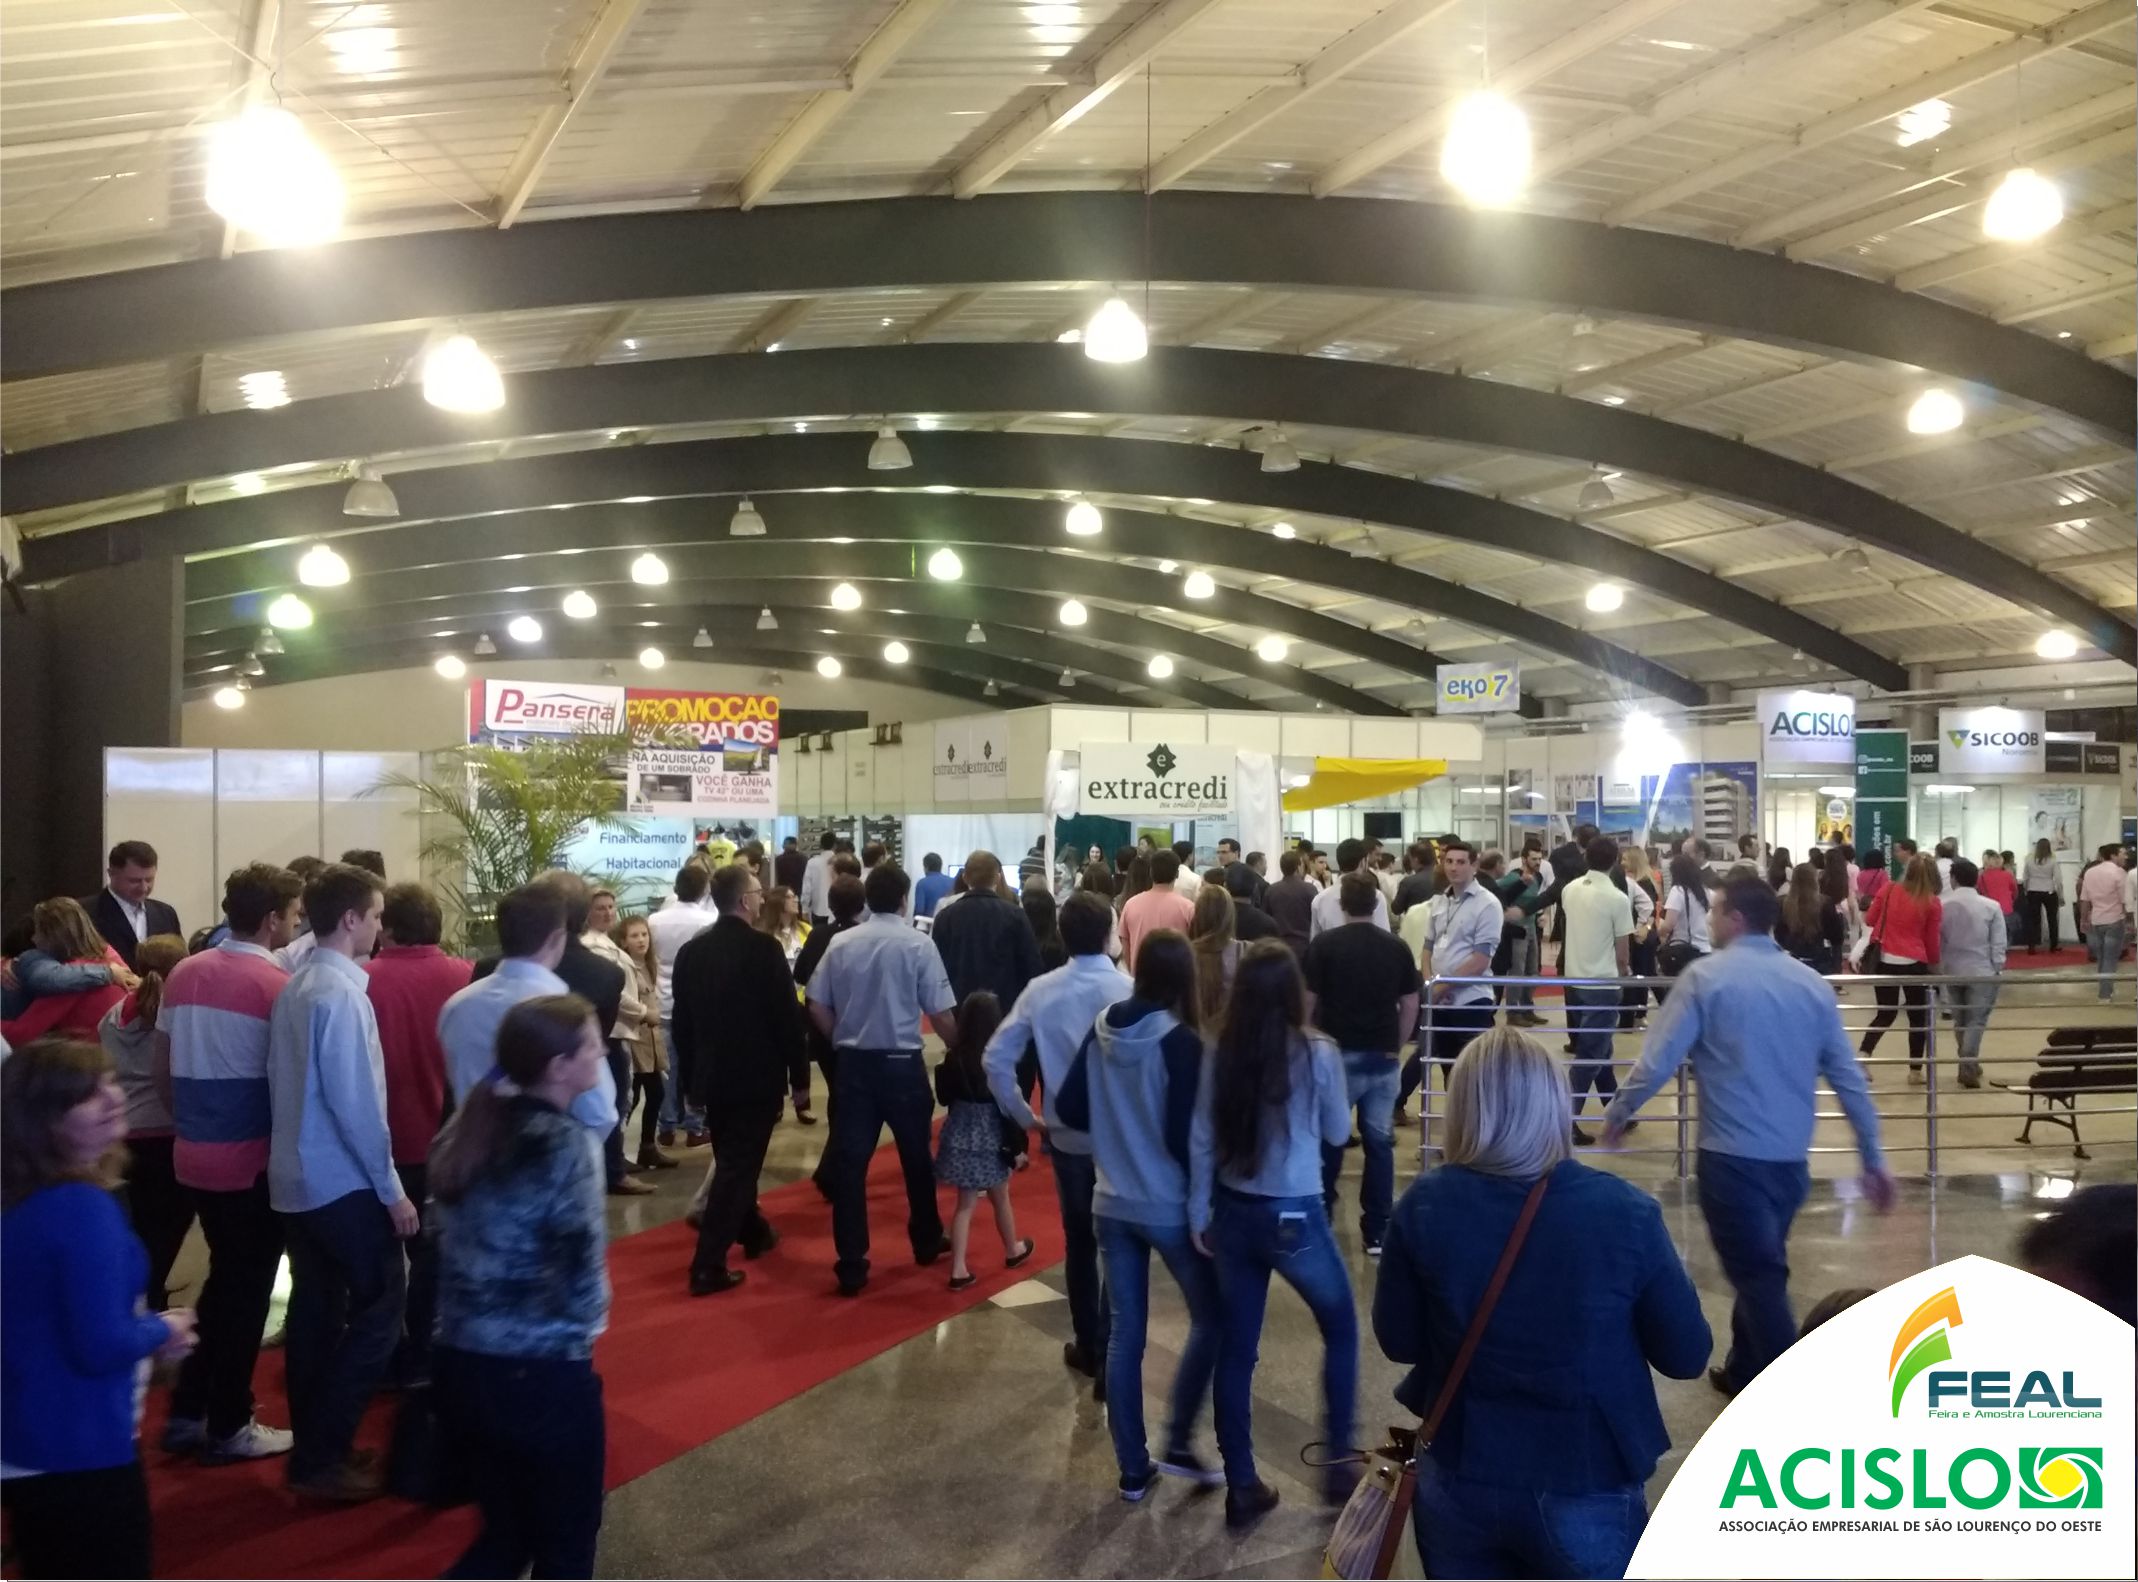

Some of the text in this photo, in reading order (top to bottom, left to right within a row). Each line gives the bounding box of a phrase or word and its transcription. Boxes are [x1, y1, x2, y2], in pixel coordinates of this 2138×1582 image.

[1494, 674, 1508, 697] 7
[494, 688, 616, 724] Pansera
[1770, 711, 1850, 737] ACISLO
[1971, 731, 2039, 747] SICOOB
[652, 752, 716, 766] AQUISIÇÃO
[731, 776, 772, 788] GANHA
[1088, 775, 1228, 800] extracredi
[704, 786, 716, 795] TV
[600, 831, 687, 845] Financiamento
[606, 856, 681, 870] Habitacional
